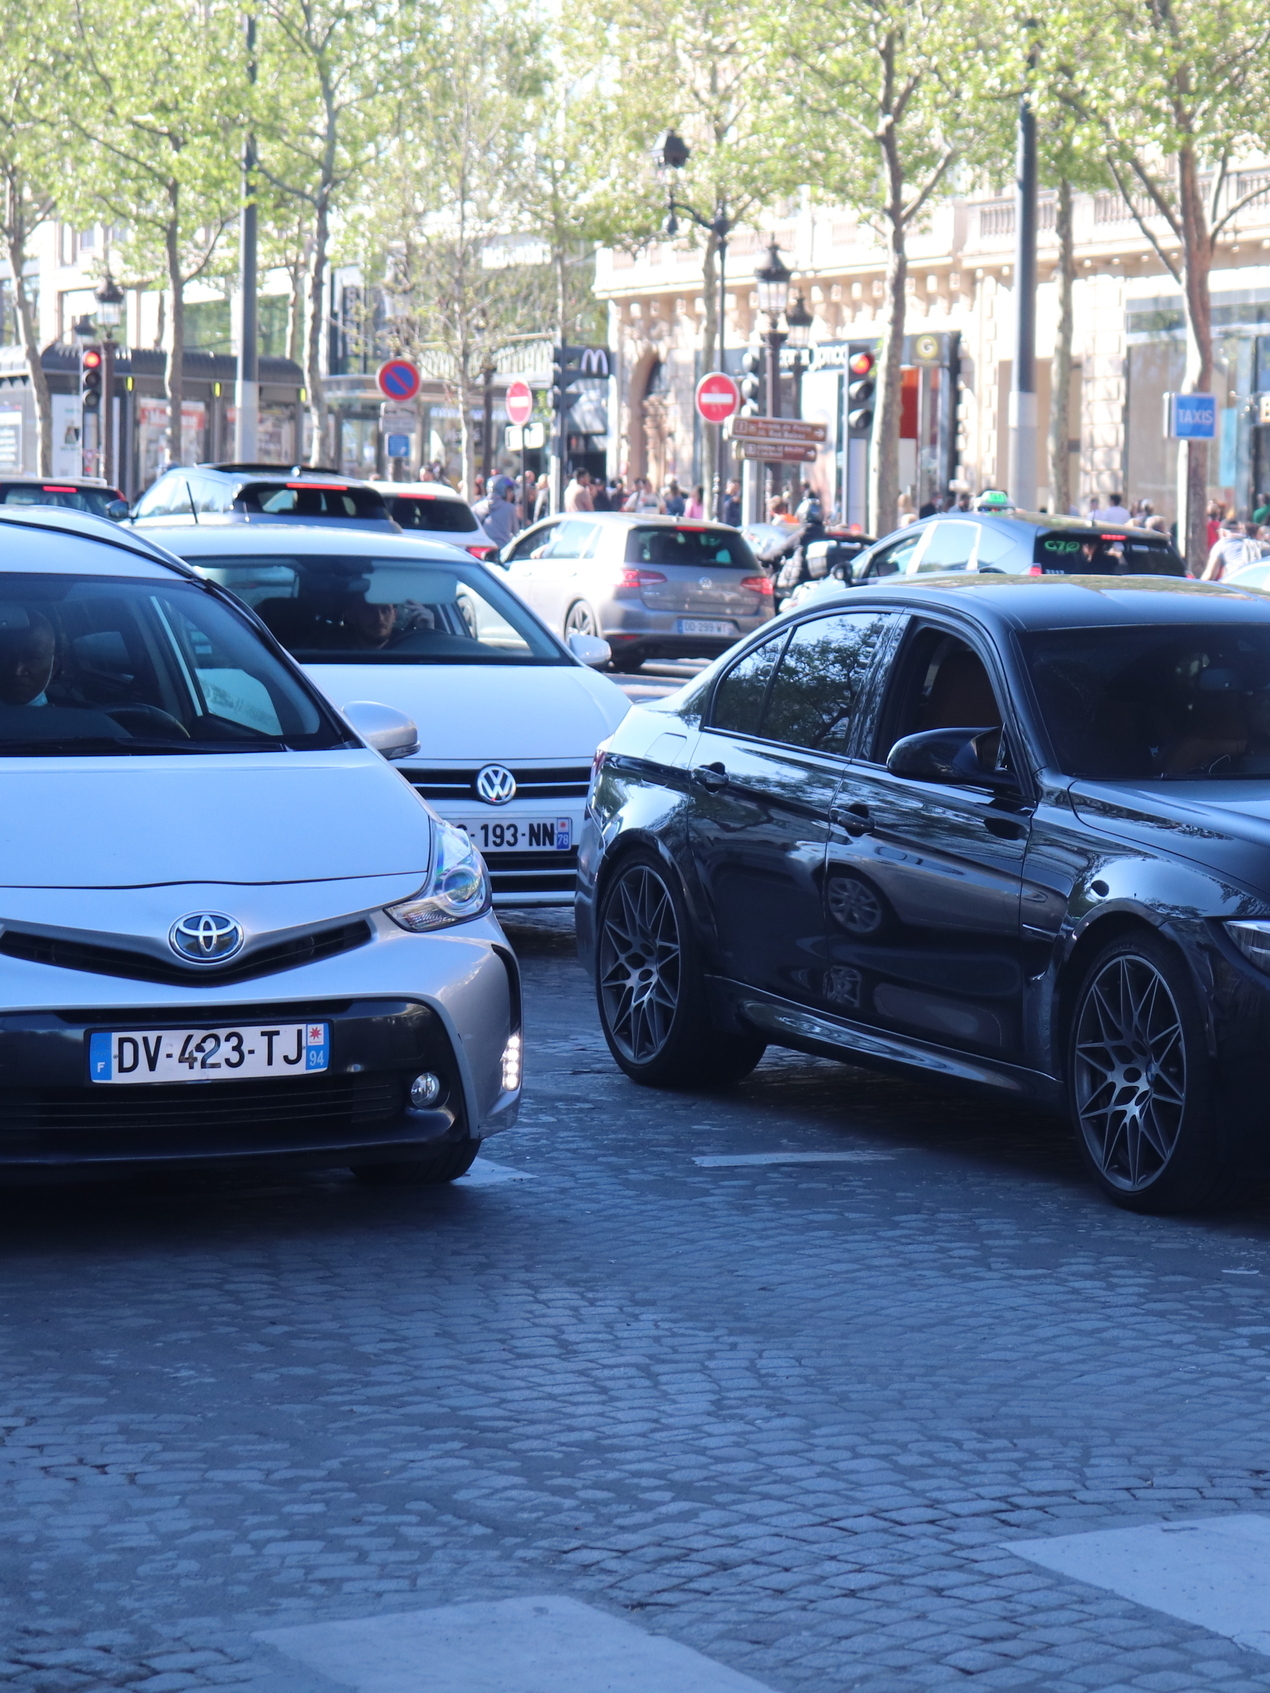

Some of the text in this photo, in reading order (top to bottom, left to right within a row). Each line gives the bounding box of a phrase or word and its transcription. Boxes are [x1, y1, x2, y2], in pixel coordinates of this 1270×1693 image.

[1178, 408, 1214, 425] TAXIS
[456, 823, 555, 848] -193-NN
[557, 833, 569, 846] 78
[117, 1028, 304, 1074] DV-423-TJ
[310, 1050, 325, 1066] 94
[97, 1062, 106, 1073] F
